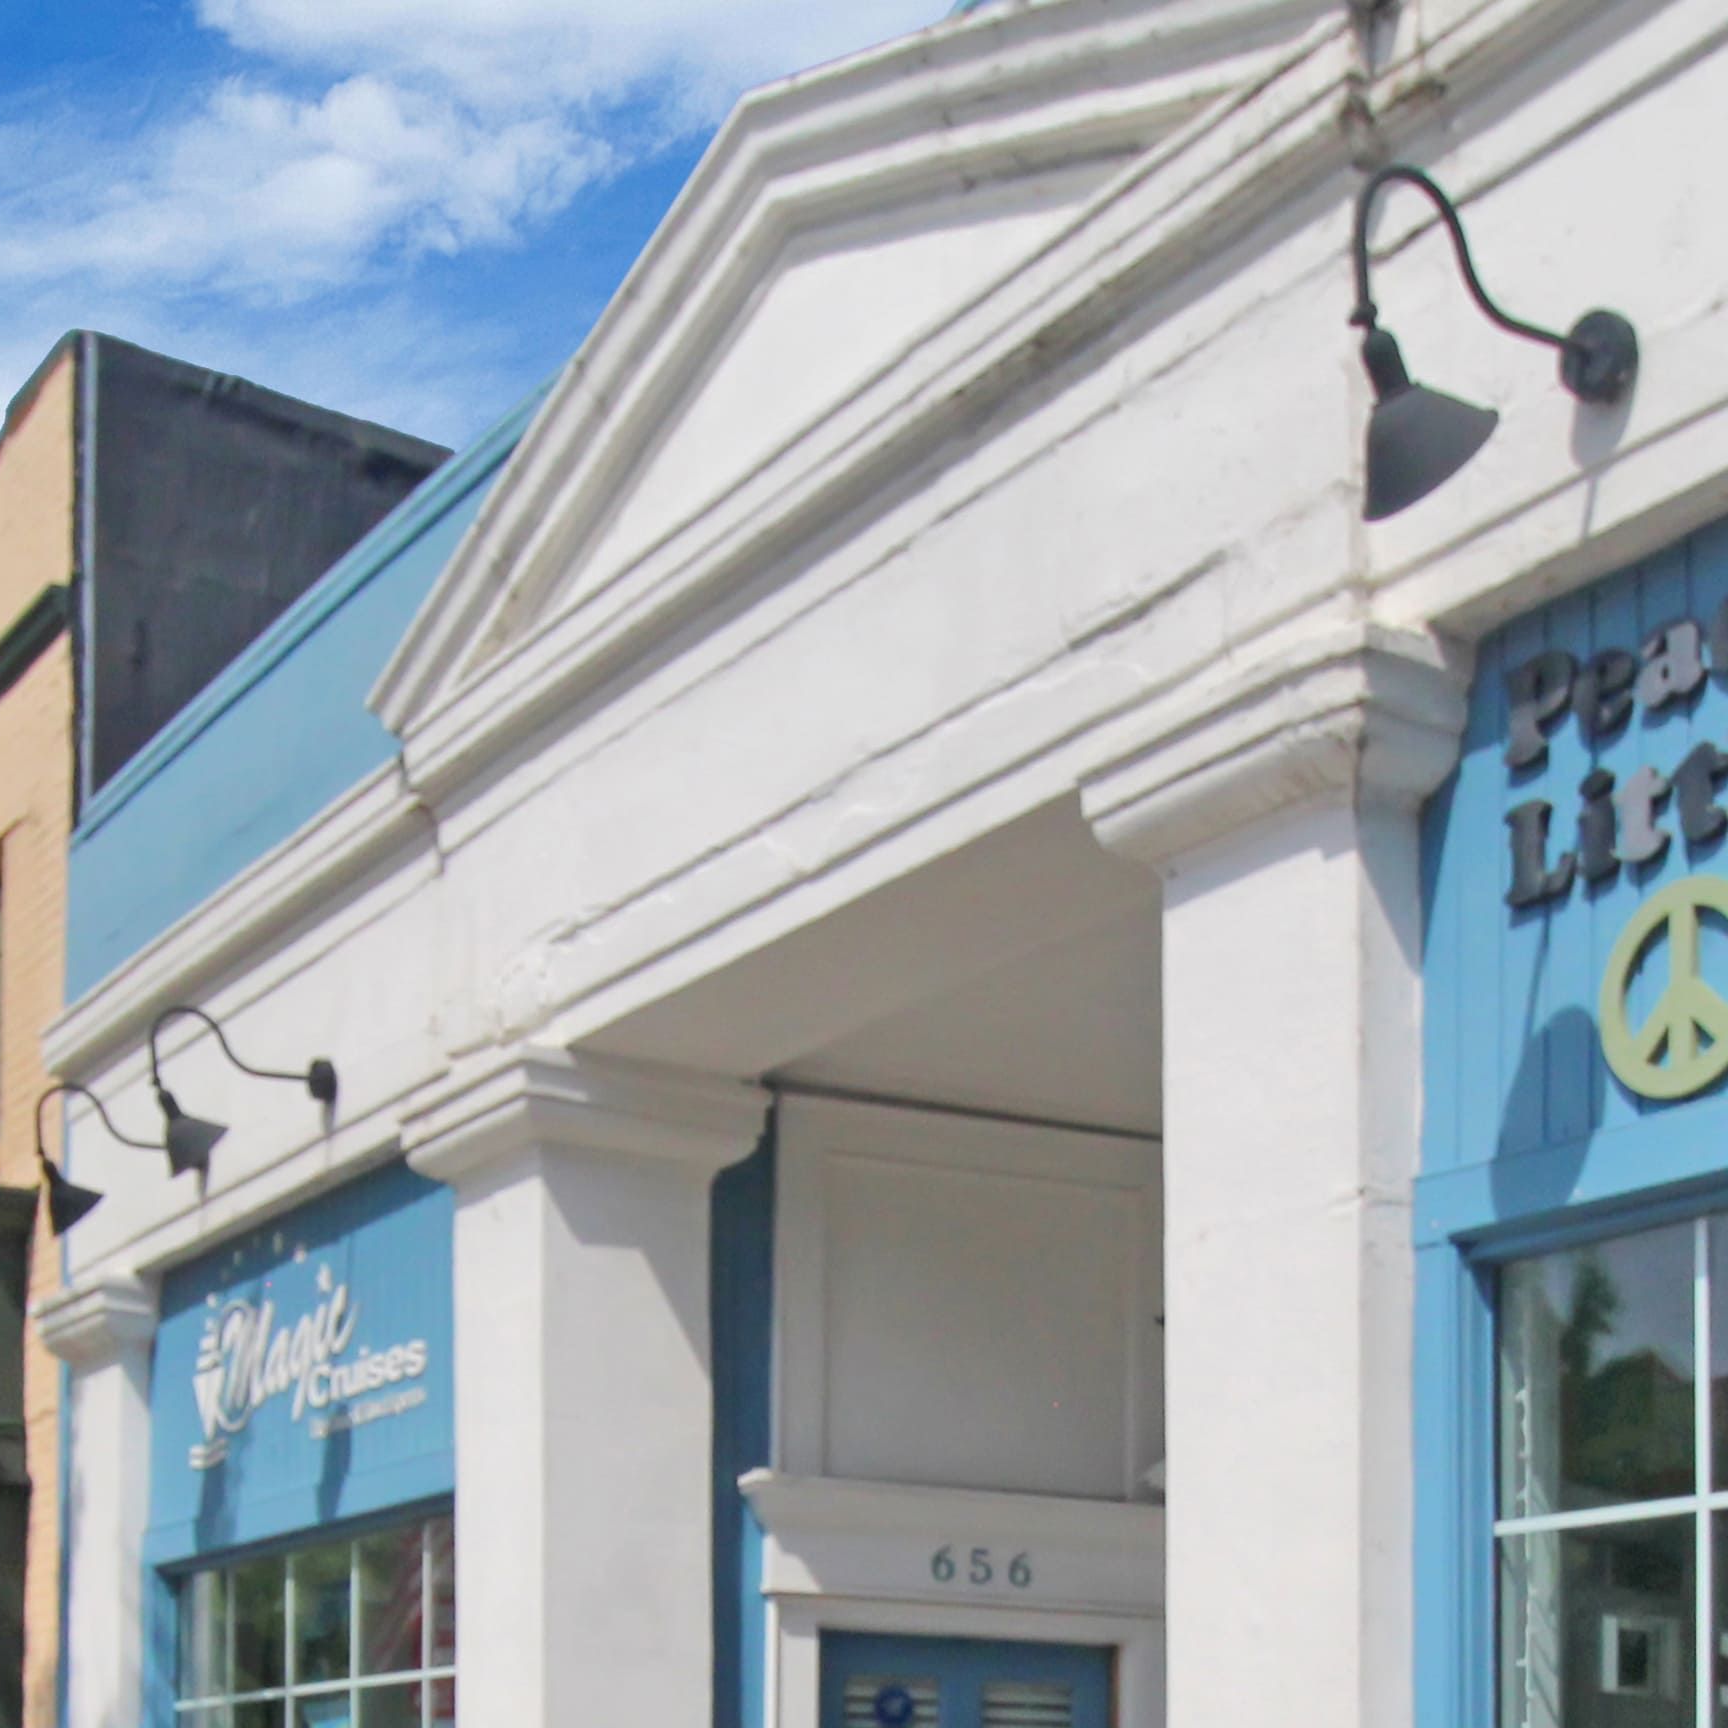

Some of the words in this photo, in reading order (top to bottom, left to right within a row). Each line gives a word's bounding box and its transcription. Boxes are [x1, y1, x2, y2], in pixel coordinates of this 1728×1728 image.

[216, 1264, 360, 1432] Magic
[308, 1339, 427, 1408] Cruises
[930, 1544, 1032, 1590] 656
